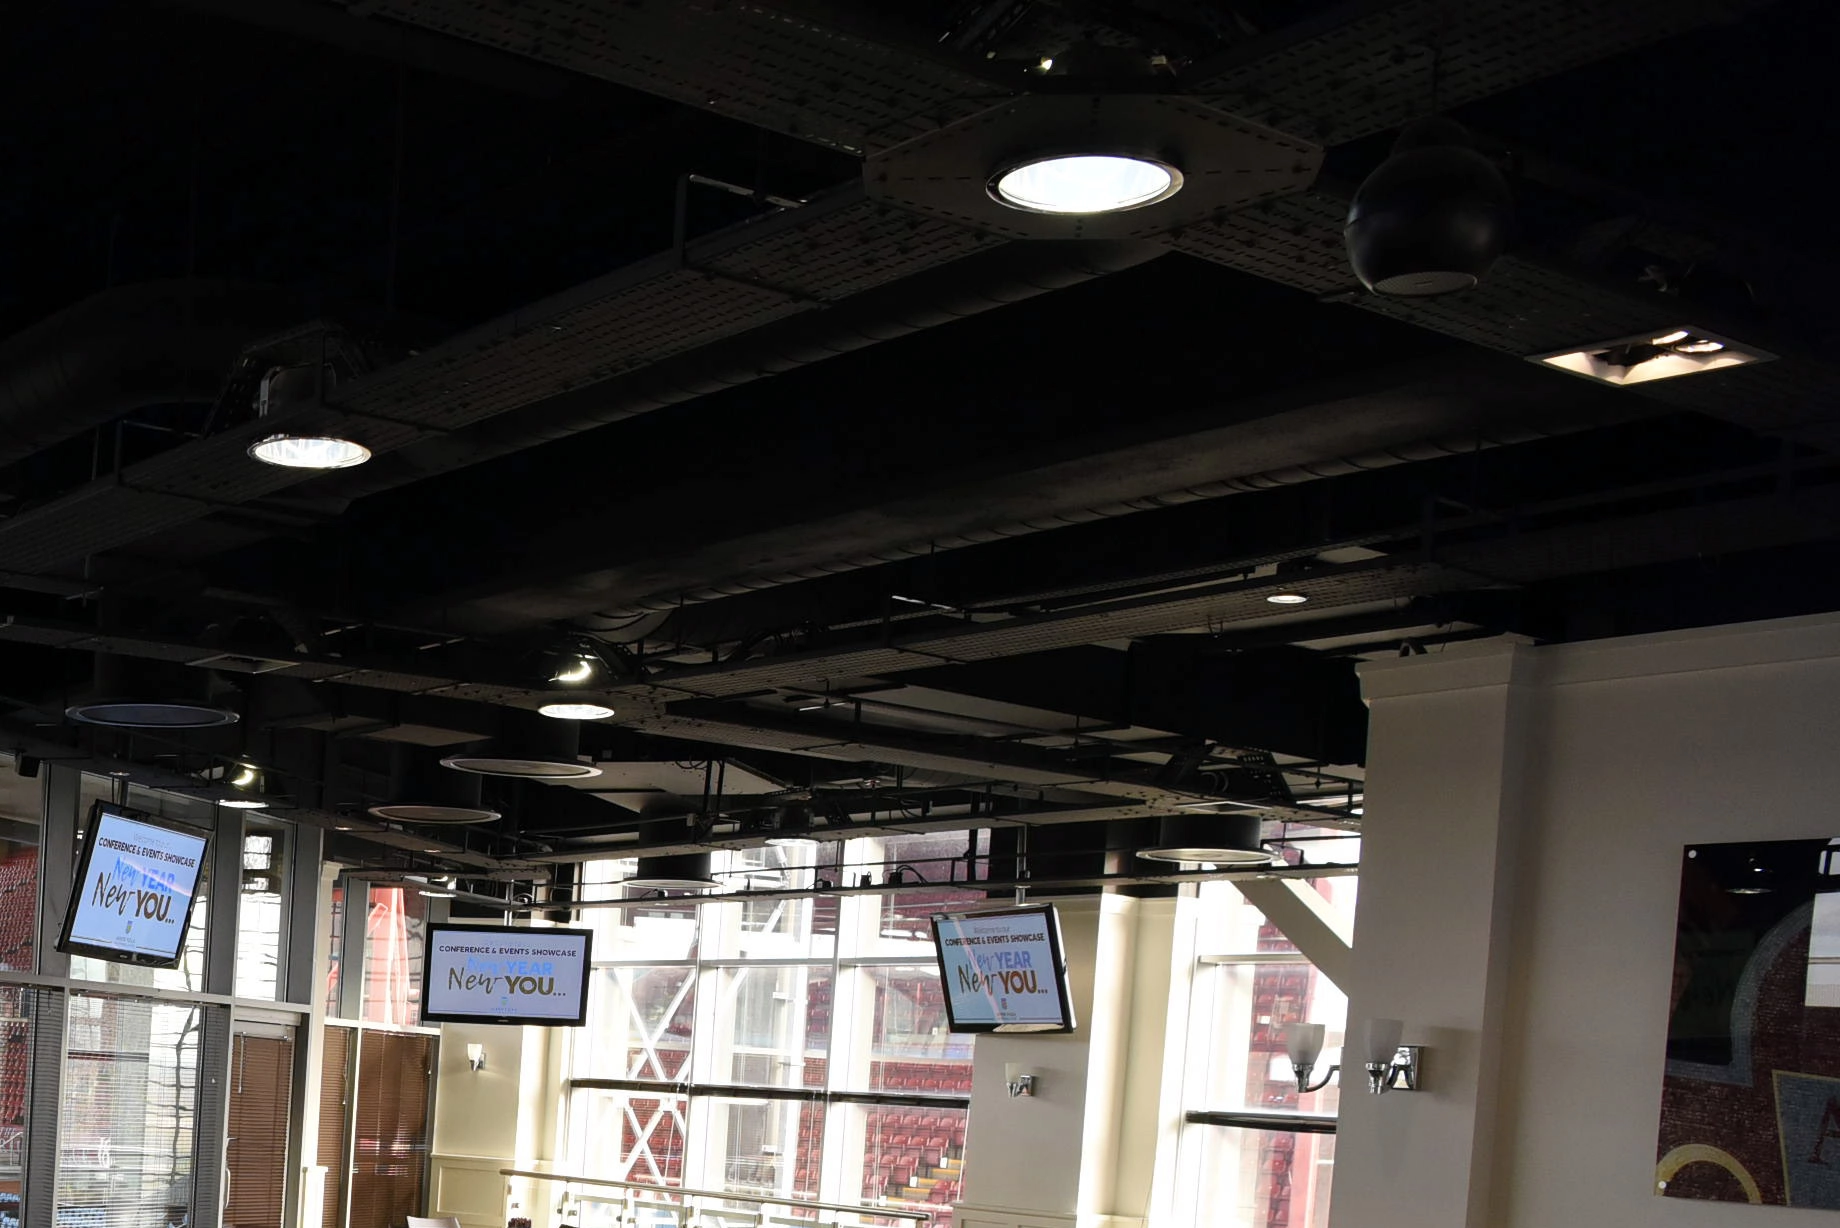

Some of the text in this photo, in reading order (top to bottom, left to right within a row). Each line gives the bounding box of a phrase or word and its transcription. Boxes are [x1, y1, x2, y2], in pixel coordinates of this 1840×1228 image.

[98, 837, 137, 856] CONFERENCE
[141, 847, 164, 861] EVENTS
[164, 853, 196, 868] SHOWCASE
[112, 856, 175, 894] New YEAR
[92, 872, 135, 916] New
[439, 945, 490, 954] CONFERENCE
[499, 947, 529, 956] EVENTS
[532, 948, 577, 957] SHOWCASE
[987, 935, 1010, 945] EVENTS
[1011, 933, 1045, 943] SHOWCASE
[505, 960, 554, 976] YEAR
[995, 950, 1032, 969] YEAR
[448, 967, 504, 995] New
[957, 964, 998, 996] New
